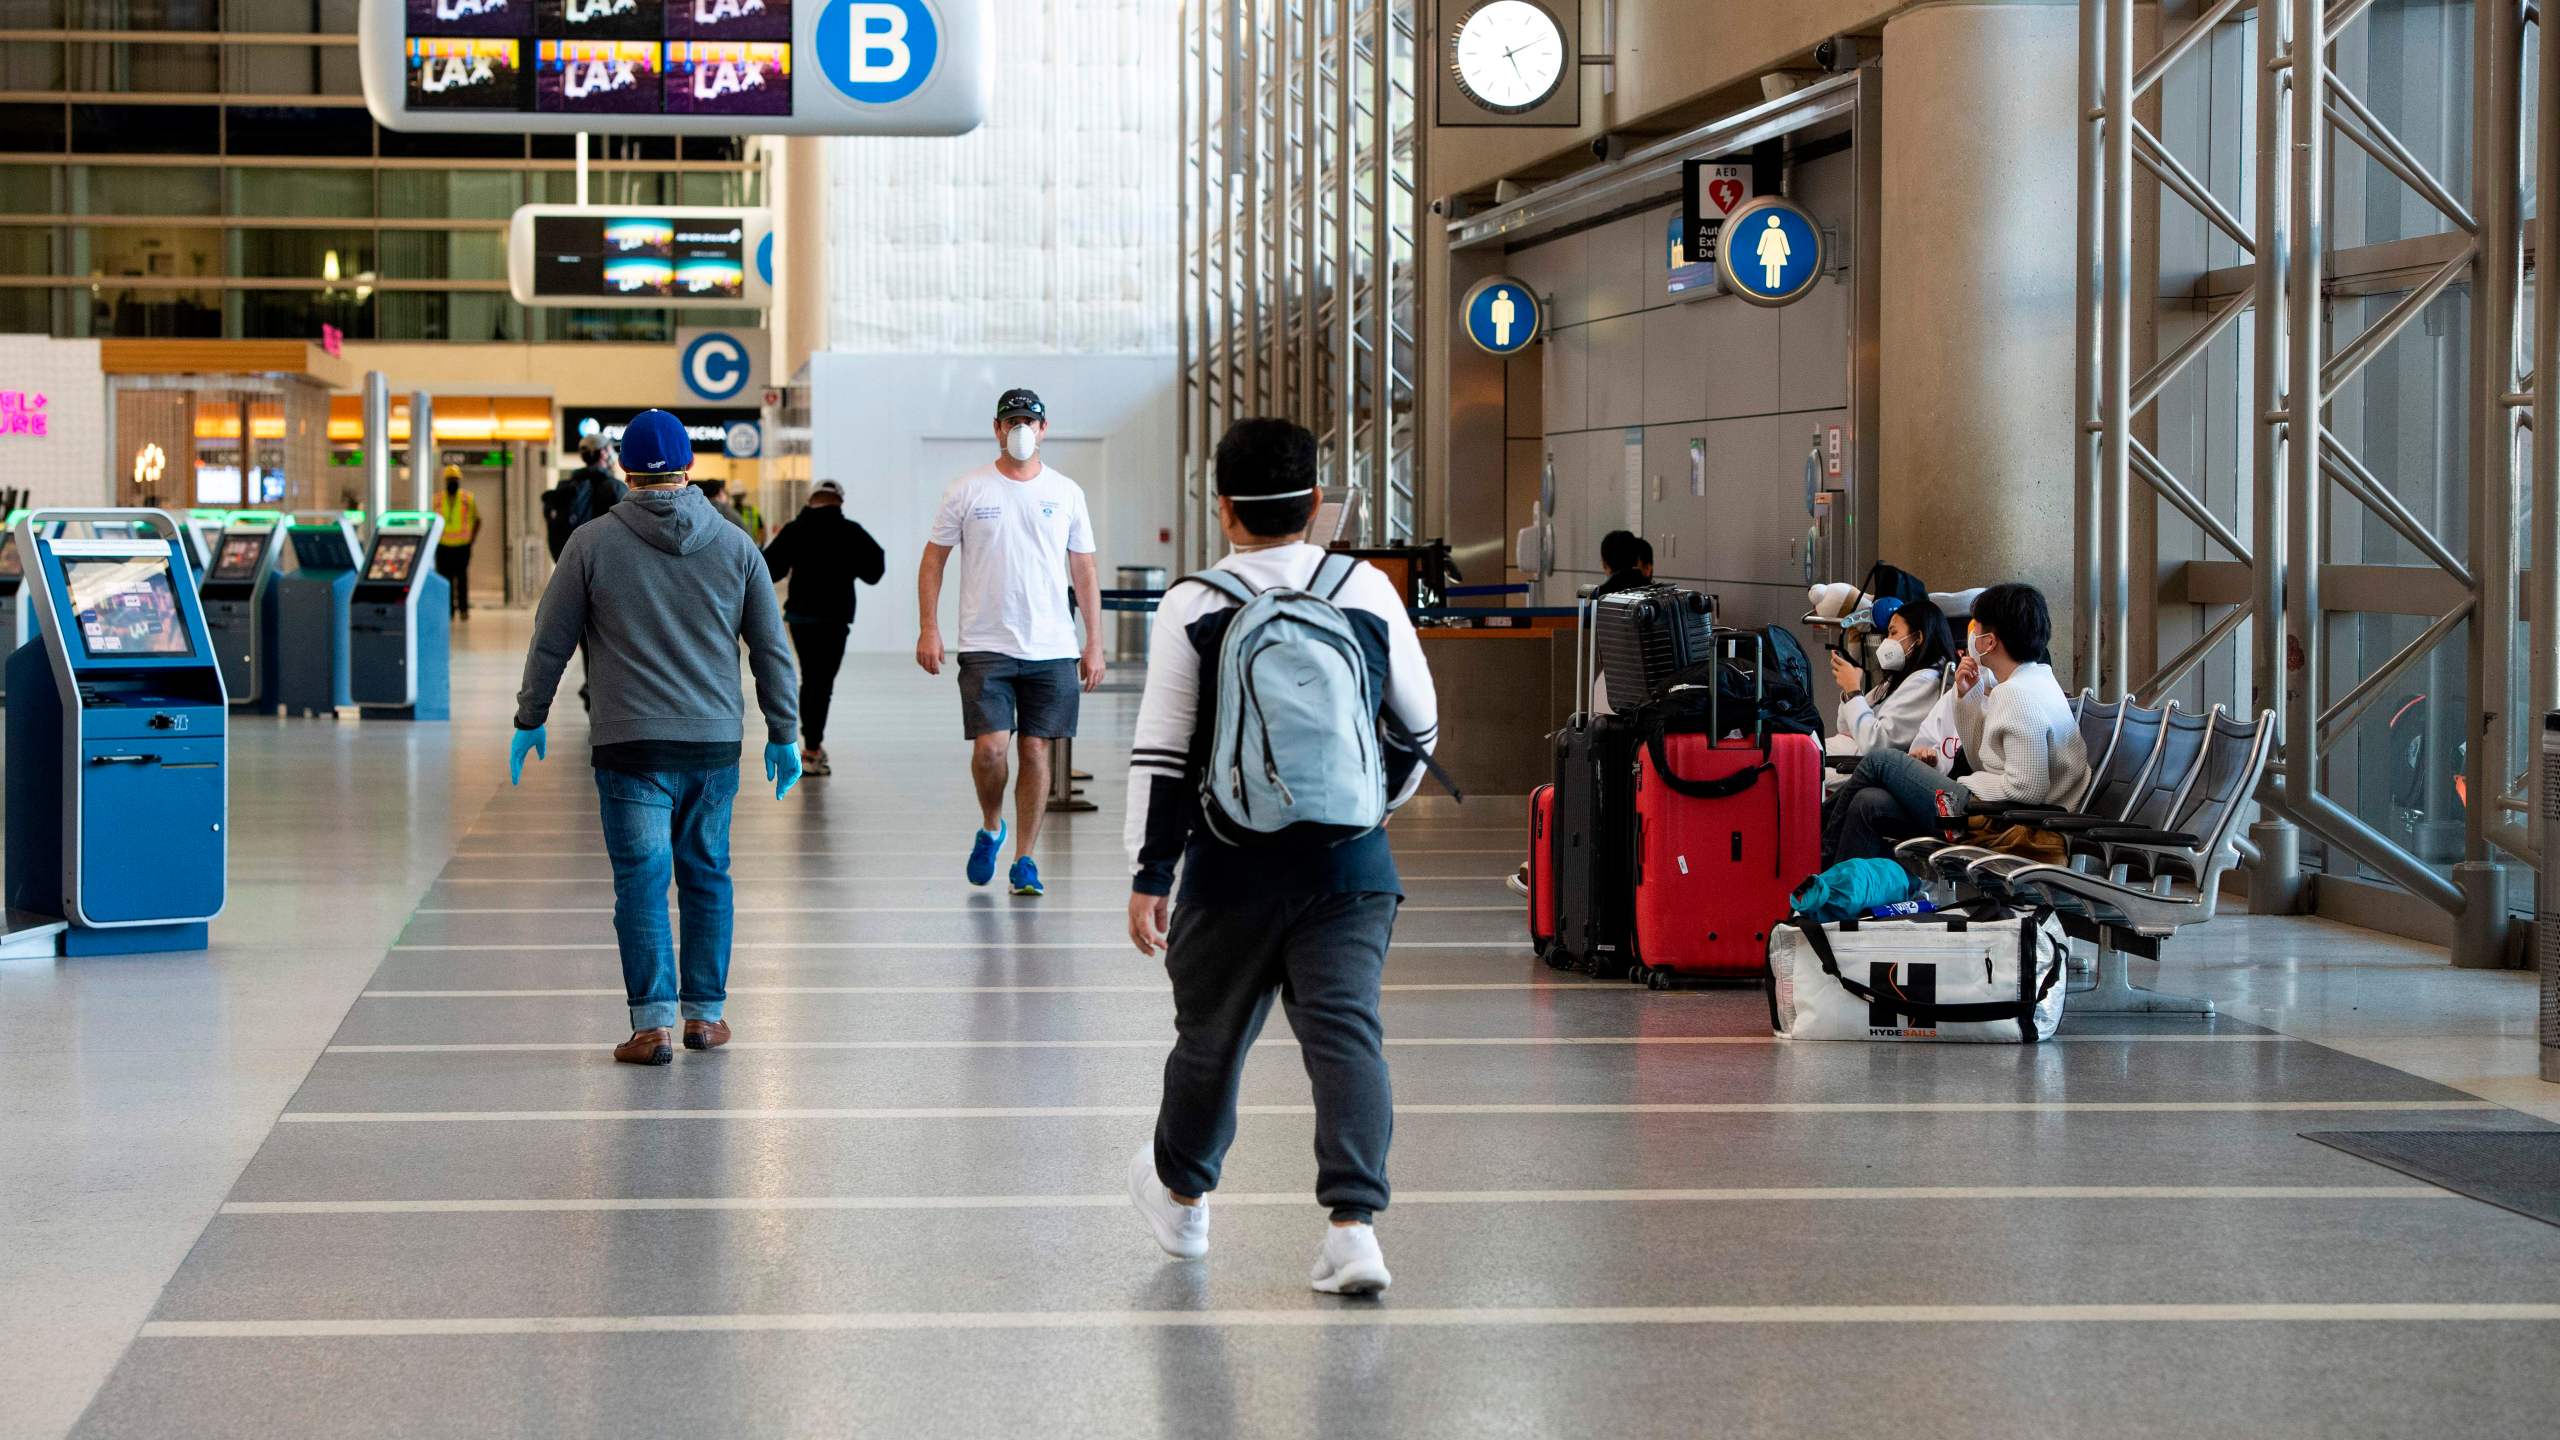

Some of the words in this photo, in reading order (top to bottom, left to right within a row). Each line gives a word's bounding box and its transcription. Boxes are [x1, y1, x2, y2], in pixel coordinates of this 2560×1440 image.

[849, 3, 910, 82] B
[423, 57, 494, 92] LAX
[565, 60, 636, 98] LAX
[695, 61, 766, 99] LAX
[1715, 168, 1737, 176] AED
[692, 341, 740, 393] C
[1870, 1029, 1937, 1037] HYDESAILS
